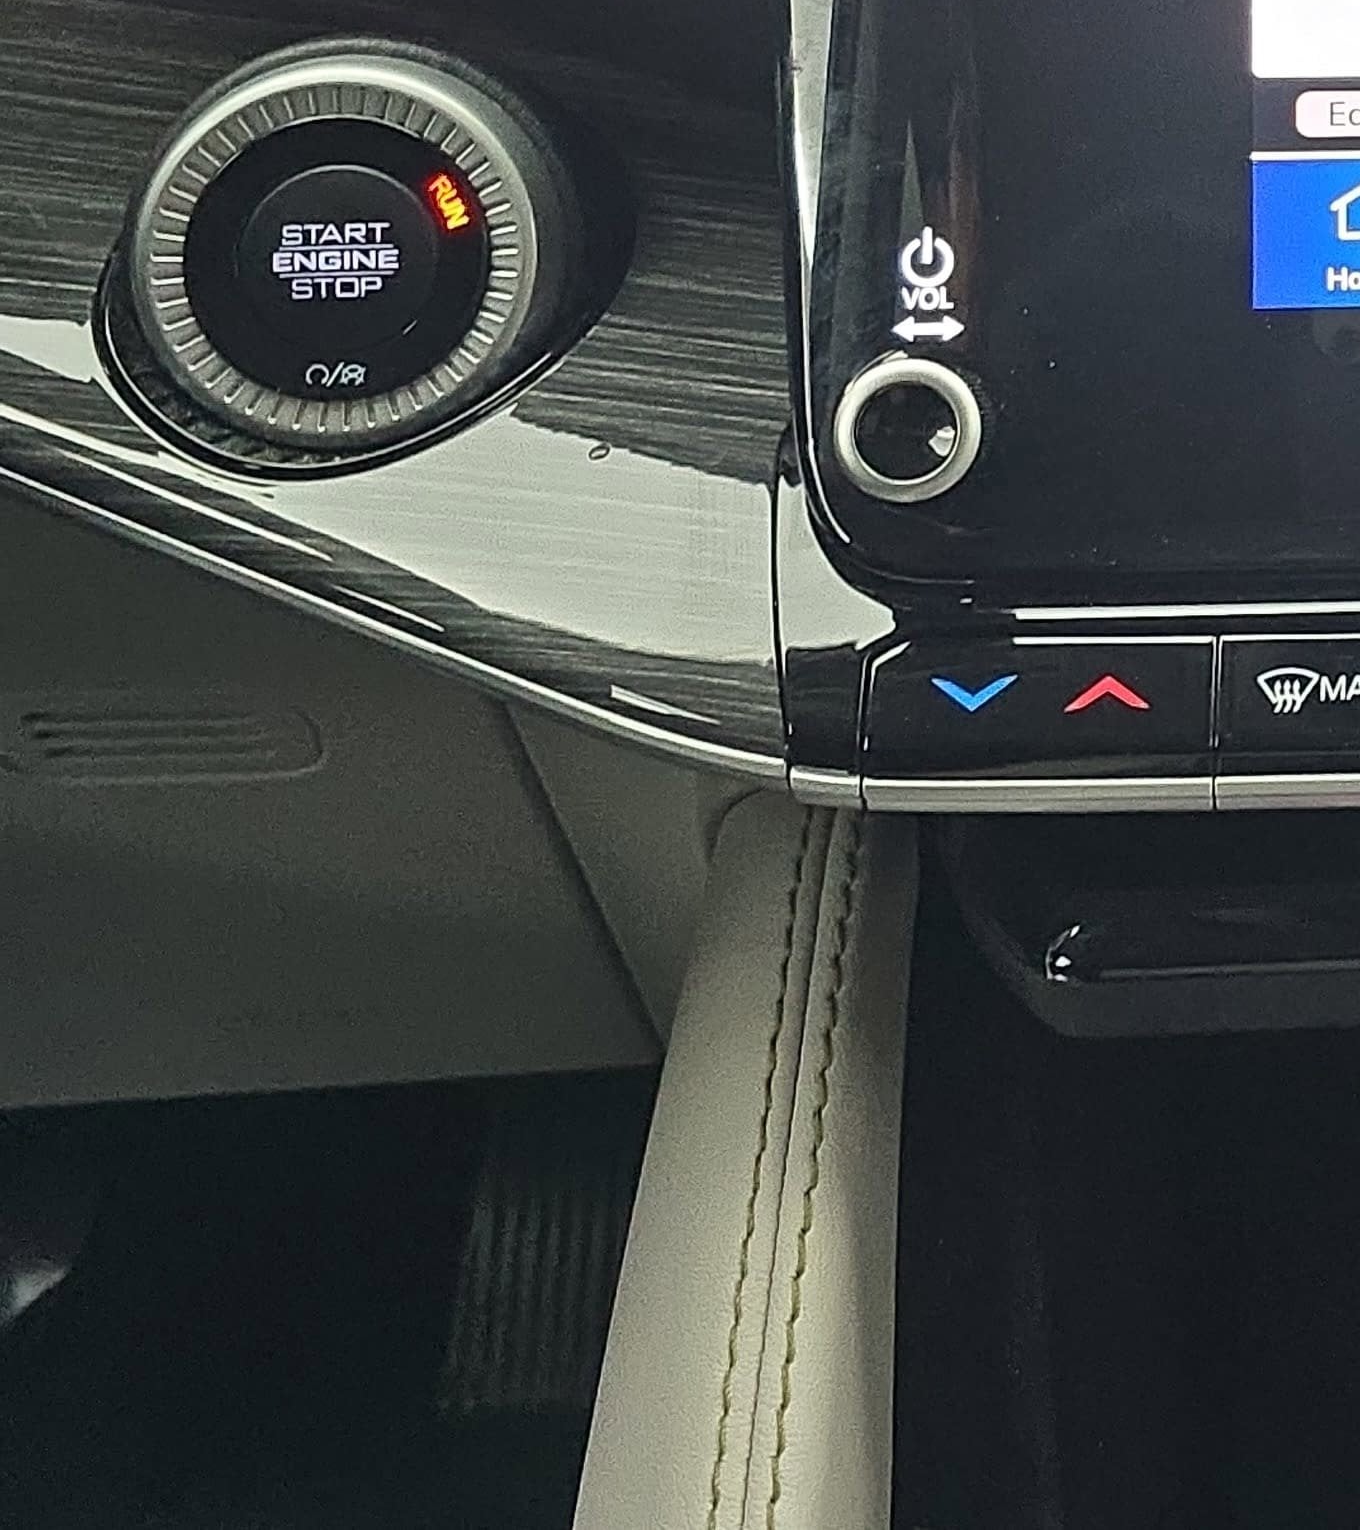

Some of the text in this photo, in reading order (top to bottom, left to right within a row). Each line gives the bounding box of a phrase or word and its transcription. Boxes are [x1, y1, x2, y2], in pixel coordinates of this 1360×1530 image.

[427, 173, 471, 231] RUN
[281, 221, 391, 247] START
[272, 249, 400, 273] ENGINE
[290, 276, 383, 300] STOP
[901, 285, 955, 311] VOL
